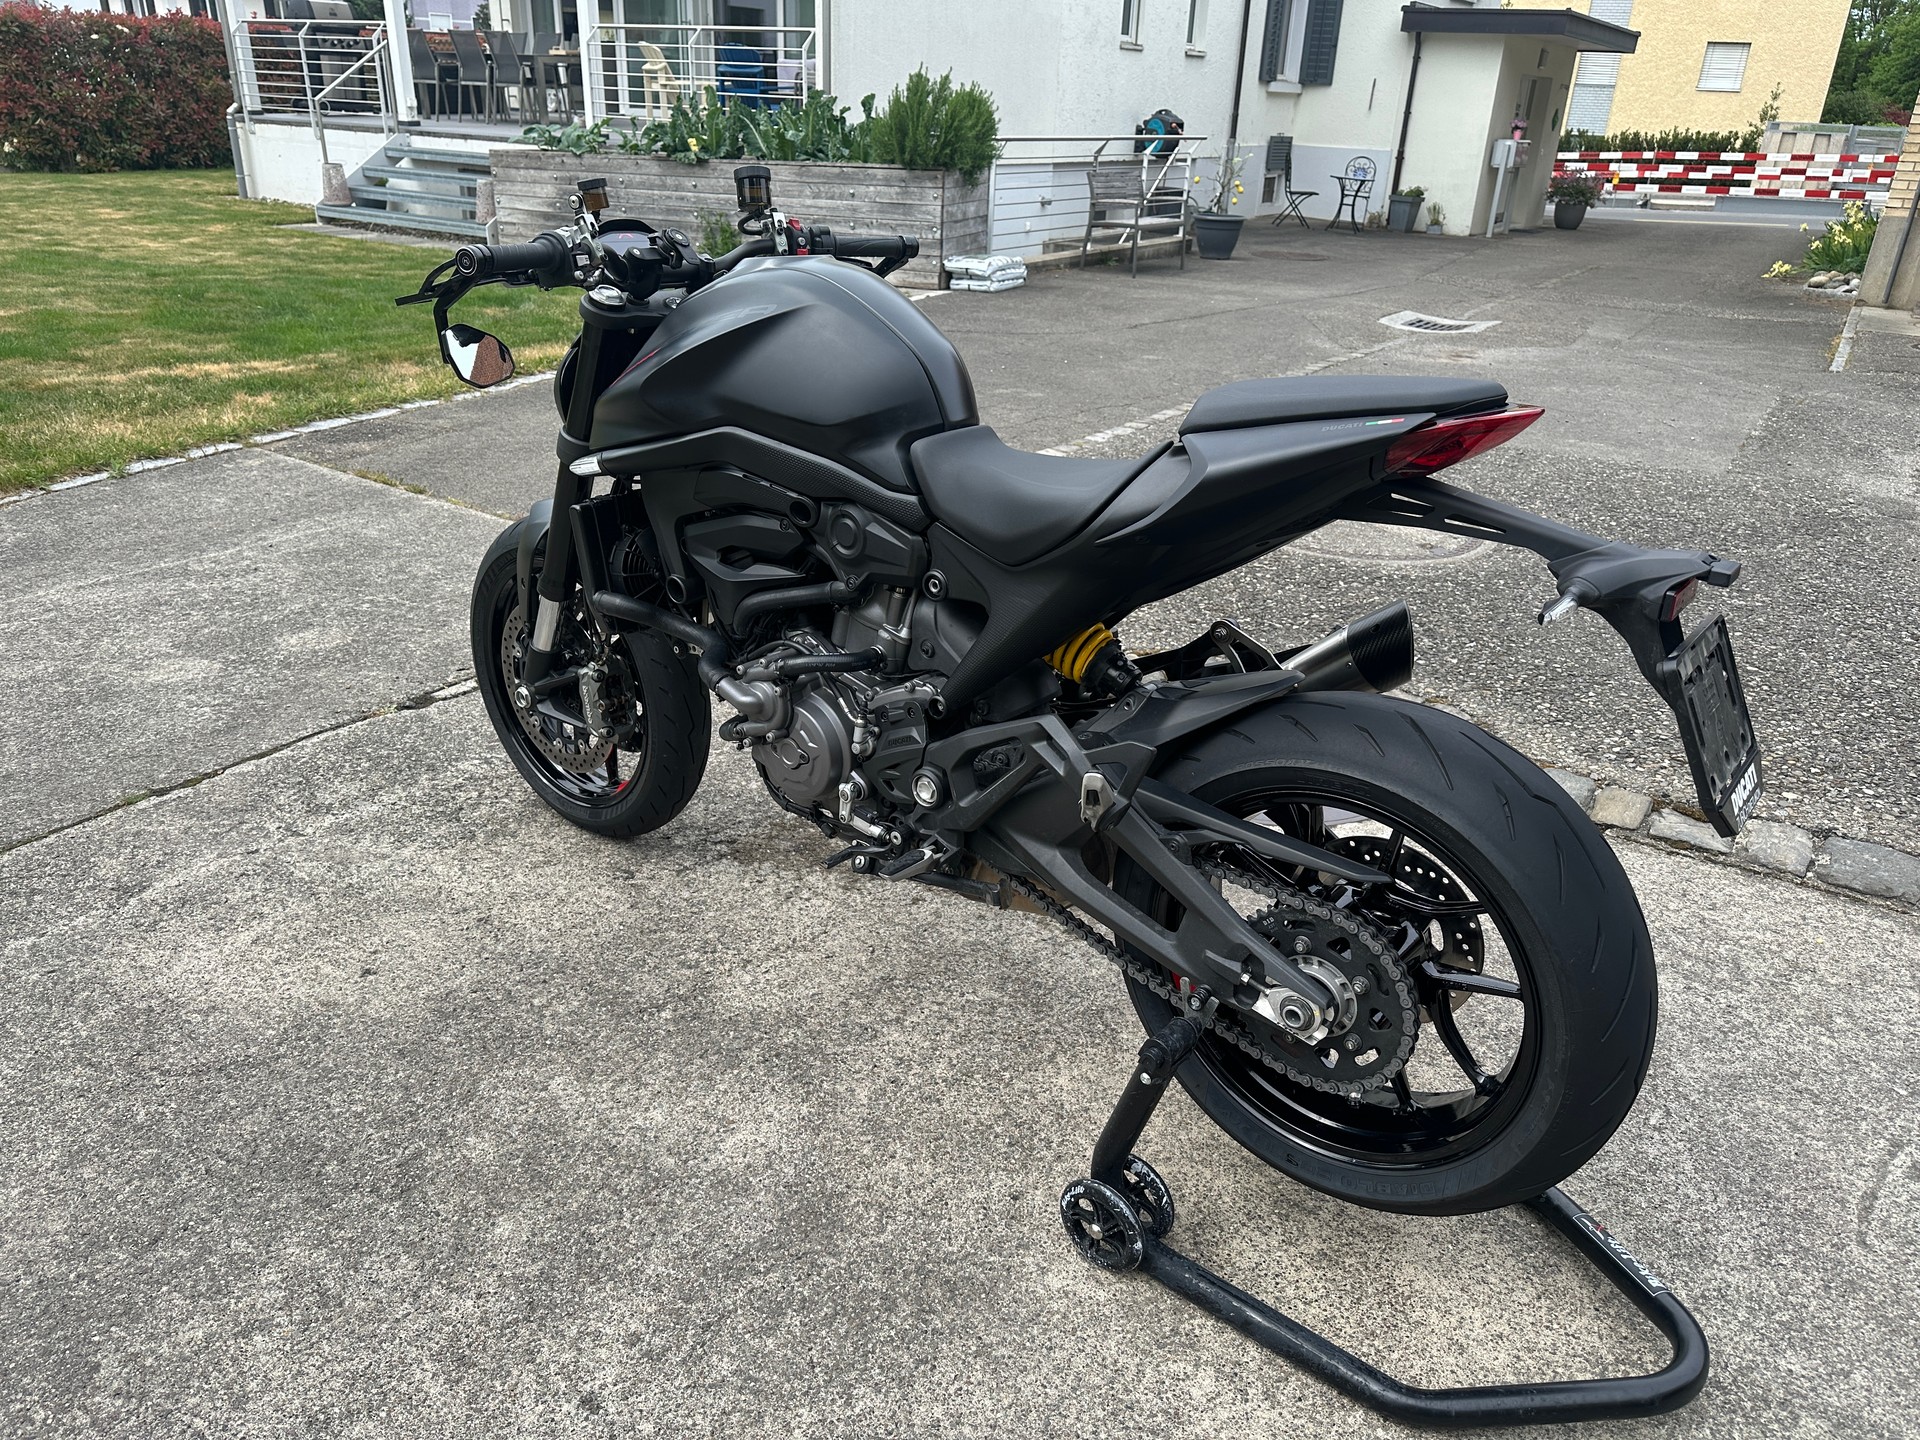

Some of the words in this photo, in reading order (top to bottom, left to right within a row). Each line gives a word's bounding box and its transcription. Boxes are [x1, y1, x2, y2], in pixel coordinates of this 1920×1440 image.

[1321, 422, 1363, 431] DUCATI
[1731, 762, 1758, 817] DUCATI
[1341, 1174, 1436, 1196] DIABLO
